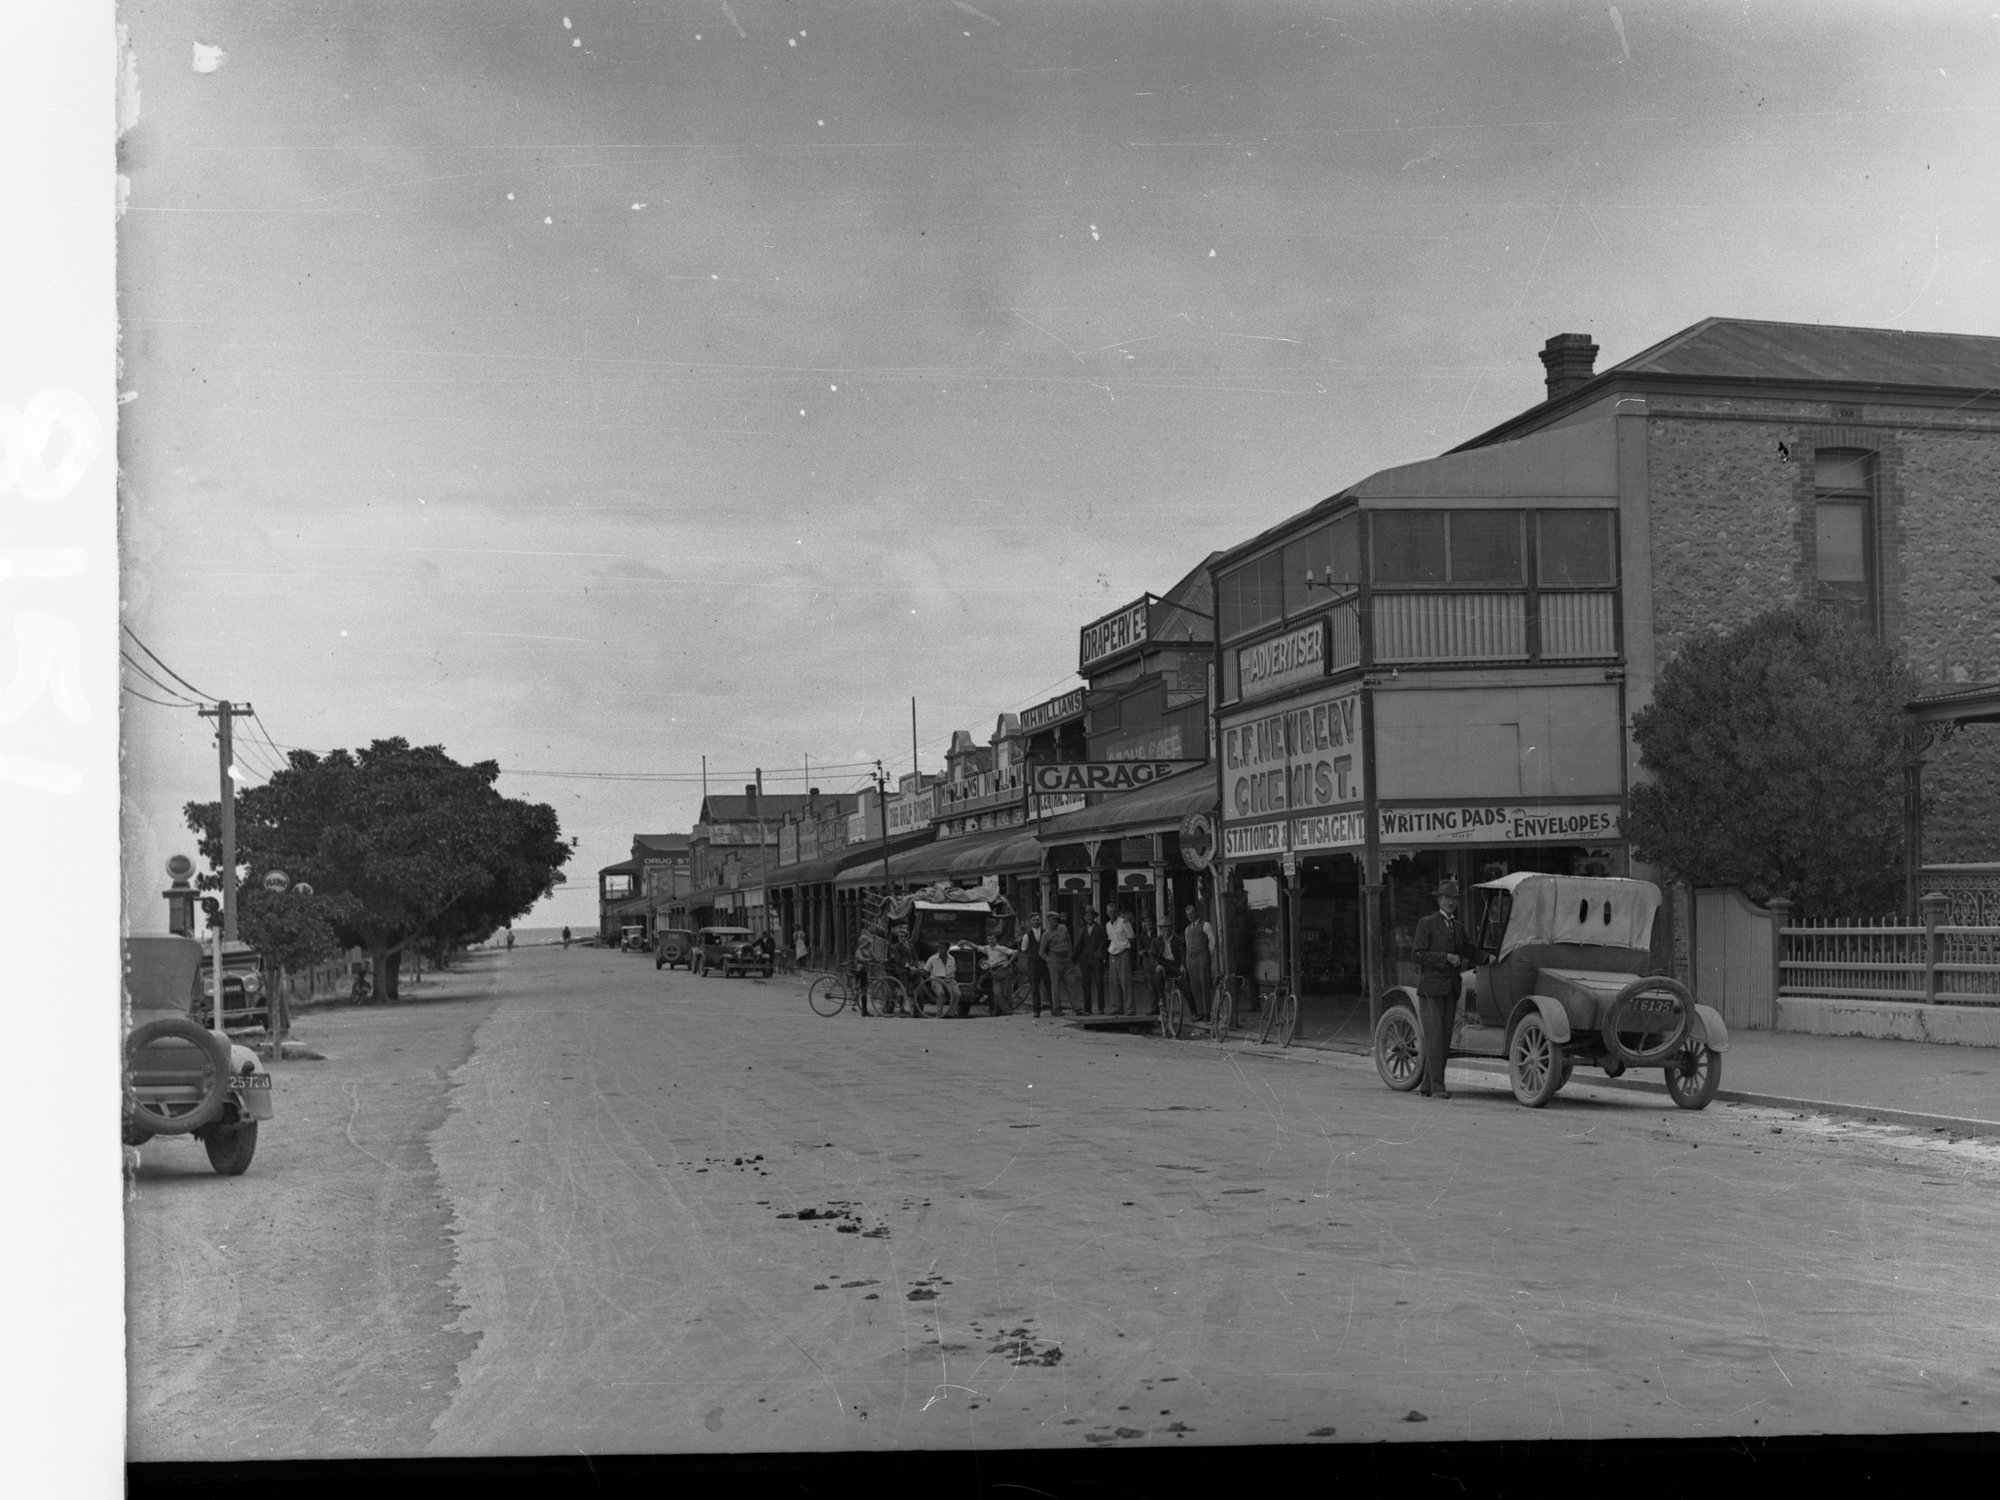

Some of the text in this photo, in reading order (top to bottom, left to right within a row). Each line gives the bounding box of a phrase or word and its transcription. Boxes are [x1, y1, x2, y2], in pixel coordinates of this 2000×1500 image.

[1084, 612, 1132, 662] DRAPERY
[1250, 628, 1323, 682] ADVERTISER
[1036, 763, 1172, 790] GARAGE
[1226, 823, 1279, 854] STATIONER
[1381, 811, 1457, 835] WRITING
